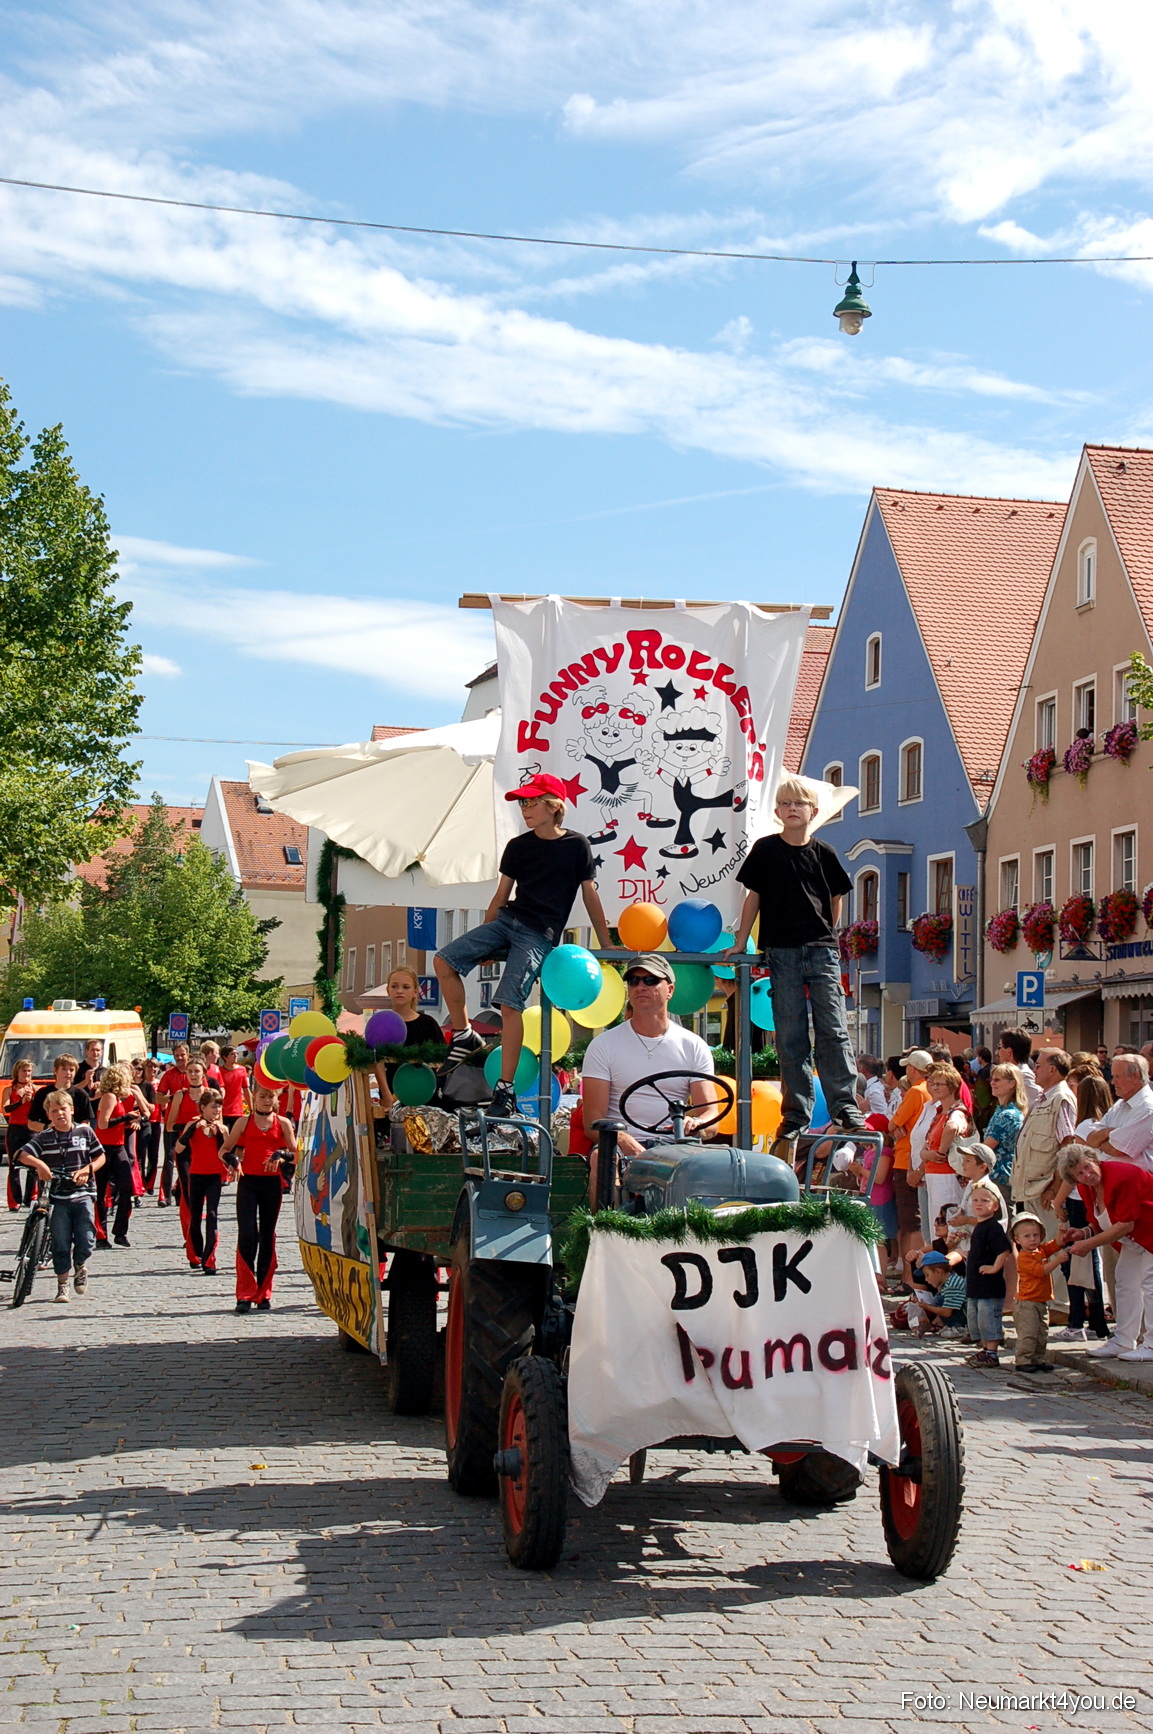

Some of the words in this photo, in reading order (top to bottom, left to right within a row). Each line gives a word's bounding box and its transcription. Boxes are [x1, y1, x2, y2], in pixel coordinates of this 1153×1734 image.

[617, 879, 668, 904] DJK
[959, 904, 973, 974] WITTL
[1023, 976, 1038, 1003] P
[661, 1240, 813, 1310] DJK
